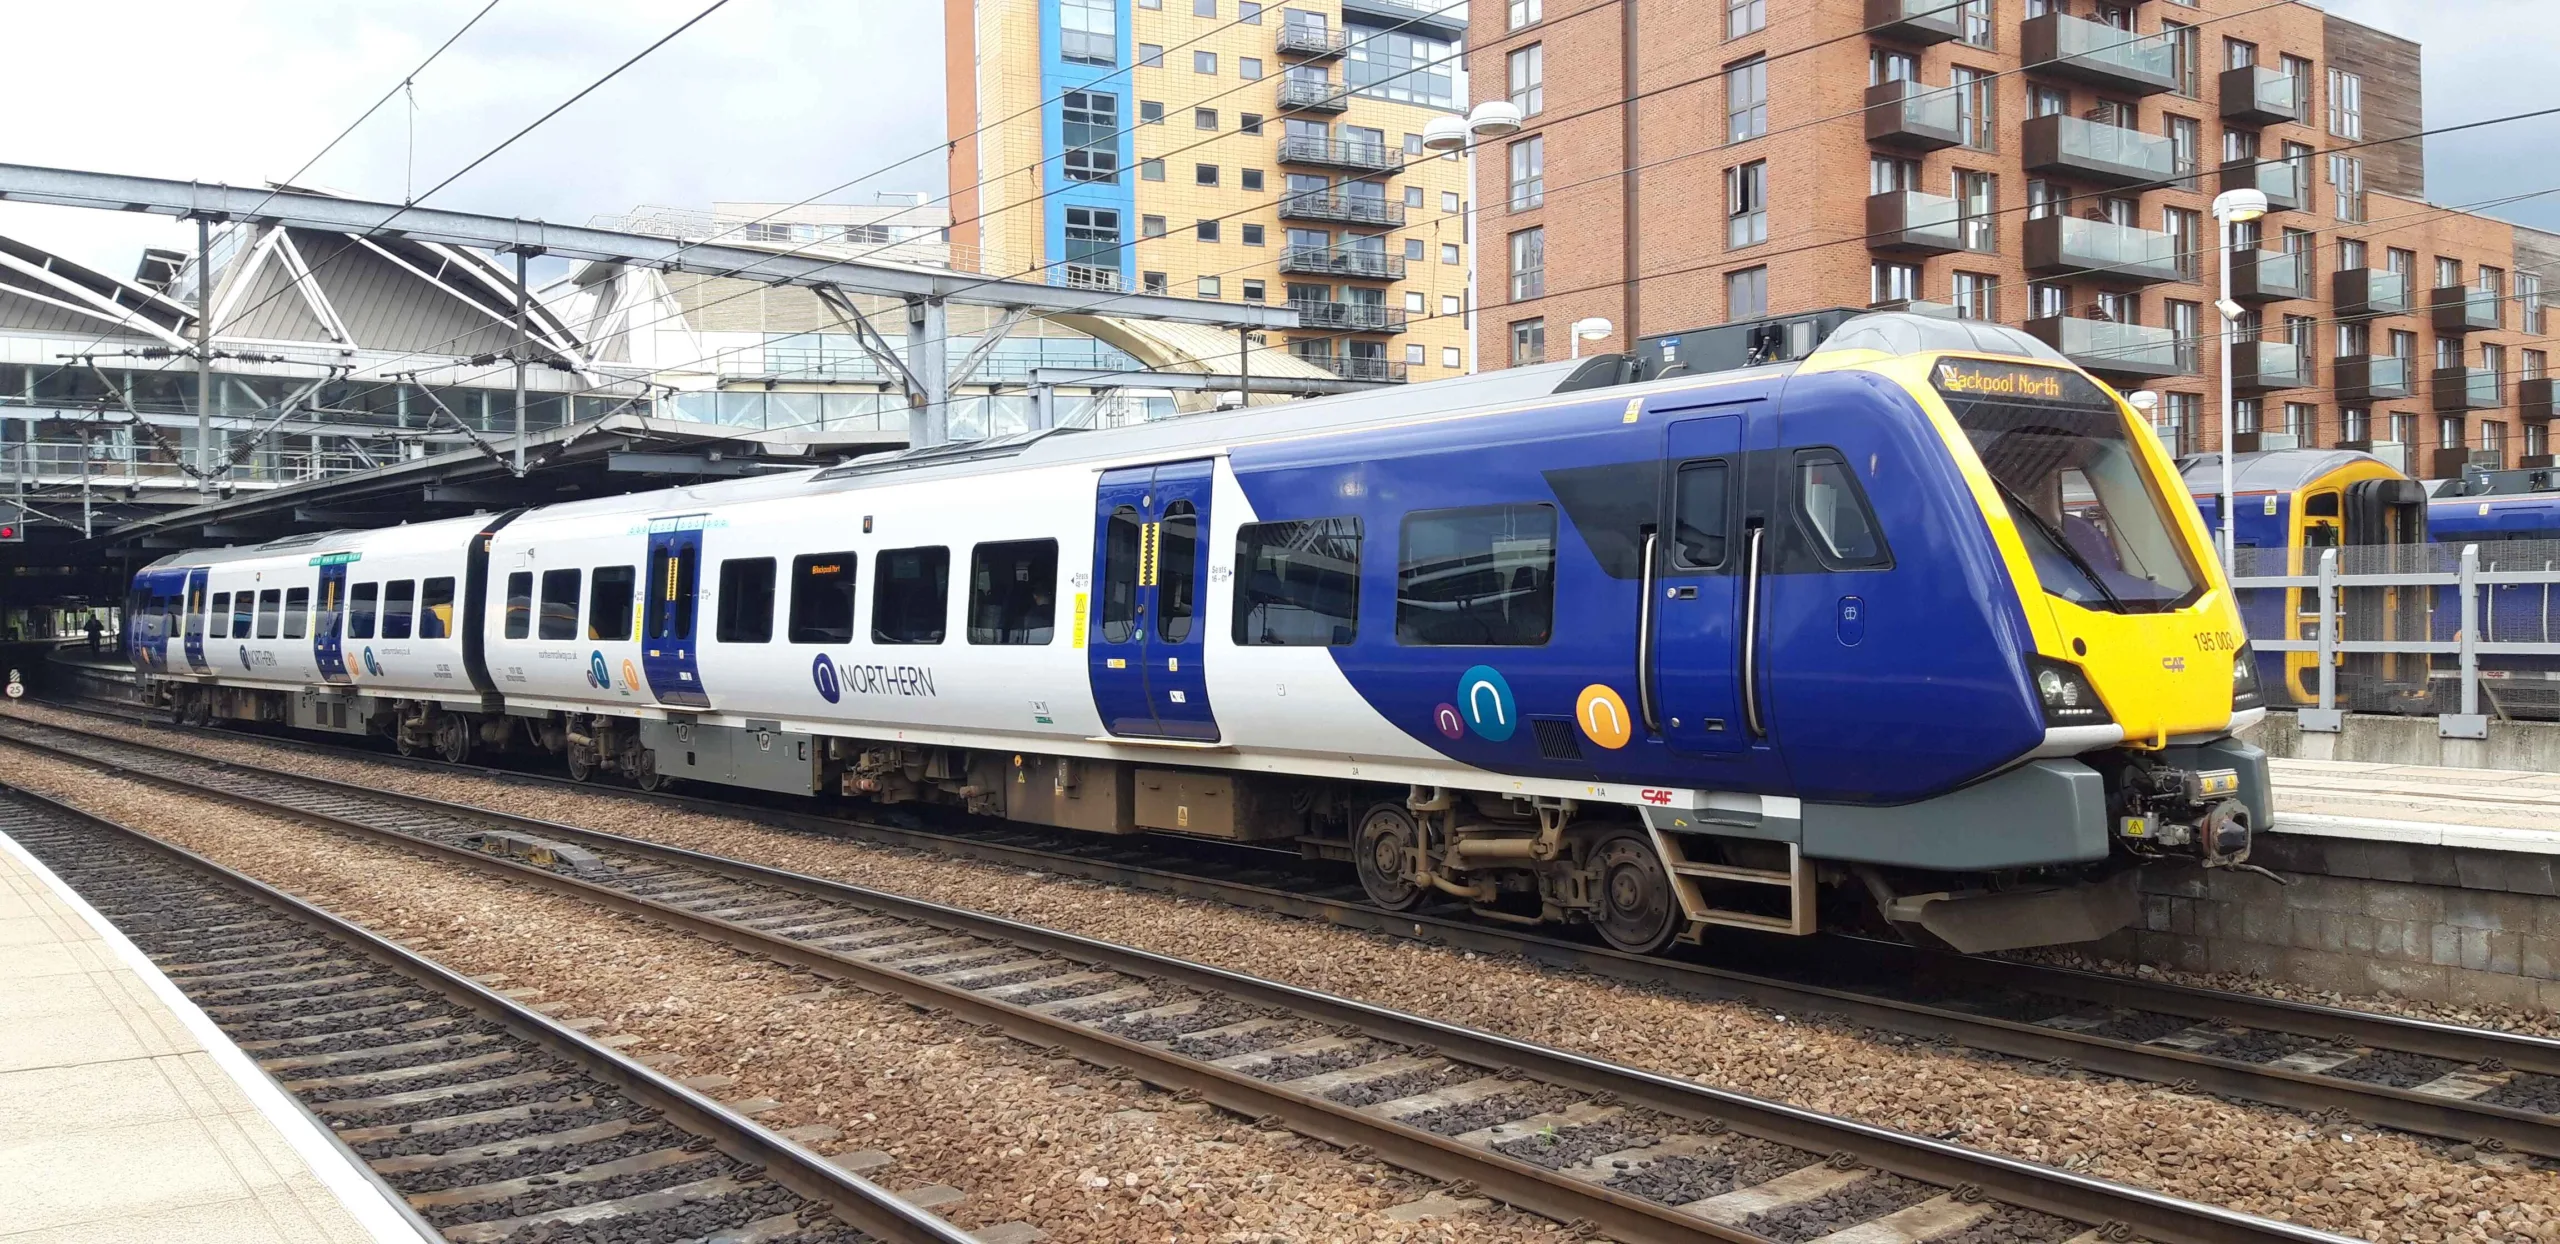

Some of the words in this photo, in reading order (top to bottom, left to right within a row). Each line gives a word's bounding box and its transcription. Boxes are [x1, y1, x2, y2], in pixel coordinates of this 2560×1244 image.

[1947, 366, 2014, 394] lackpool
[2018, 374, 2060, 396] North
[2193, 631, 2215, 652] 195
[2215, 631, 2235, 651] 003
[2162, 656, 2185, 673] CAF
[839, 664, 937, 697] NORTHERN
[9, 685, 21, 695] 25
[1597, 787, 1606, 798] 1A
[1641, 788, 1673, 805] CAF
